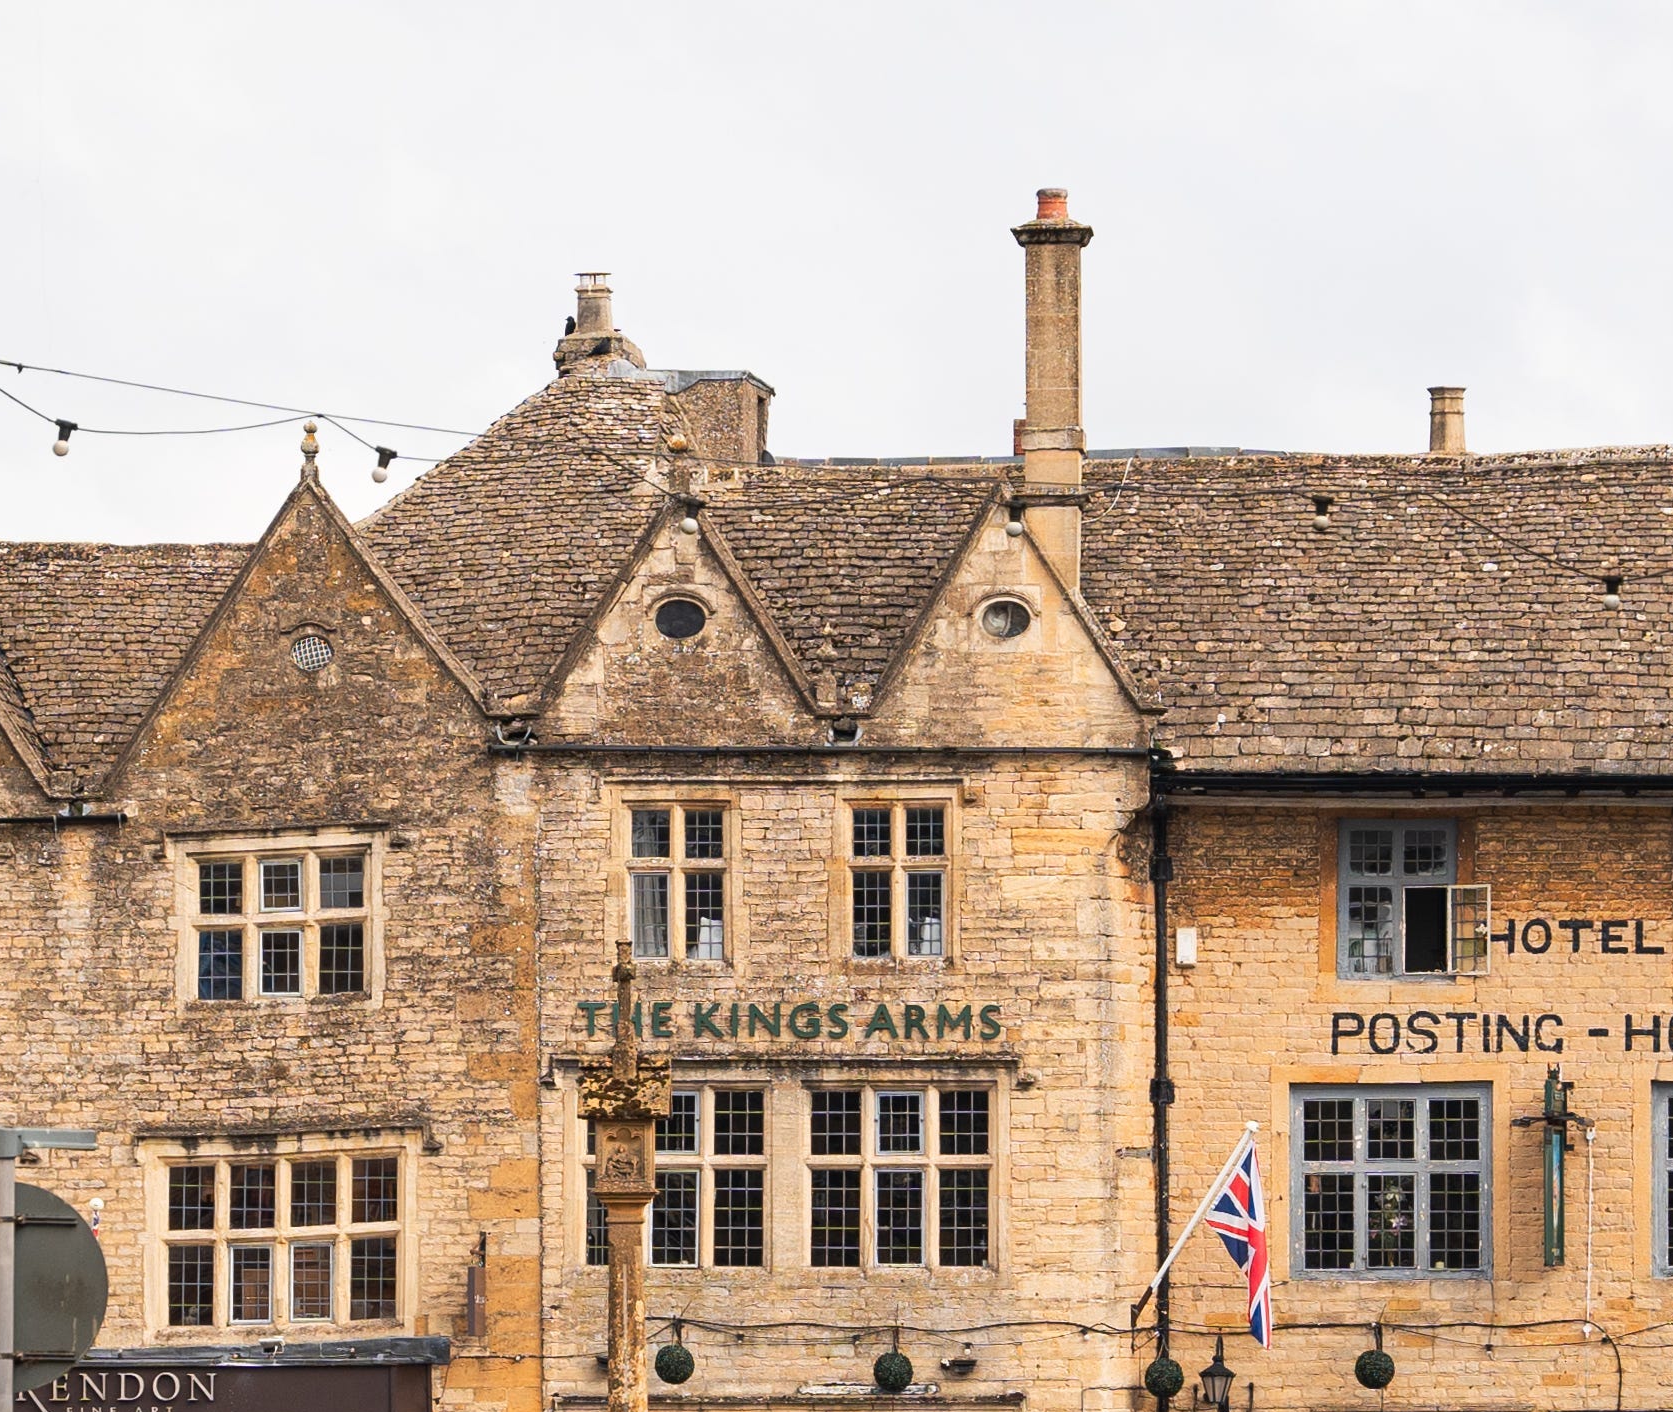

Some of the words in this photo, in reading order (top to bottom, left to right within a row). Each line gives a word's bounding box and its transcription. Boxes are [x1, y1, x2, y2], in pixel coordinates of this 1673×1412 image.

[1490, 918, 1665, 955] HOTEL
[577, 1002, 672, 1038] THE
[693, 1002, 849, 1039] KINGS
[864, 1003, 1003, 1039] ARMS
[1331, 1011, 1564, 1055] POSTING
